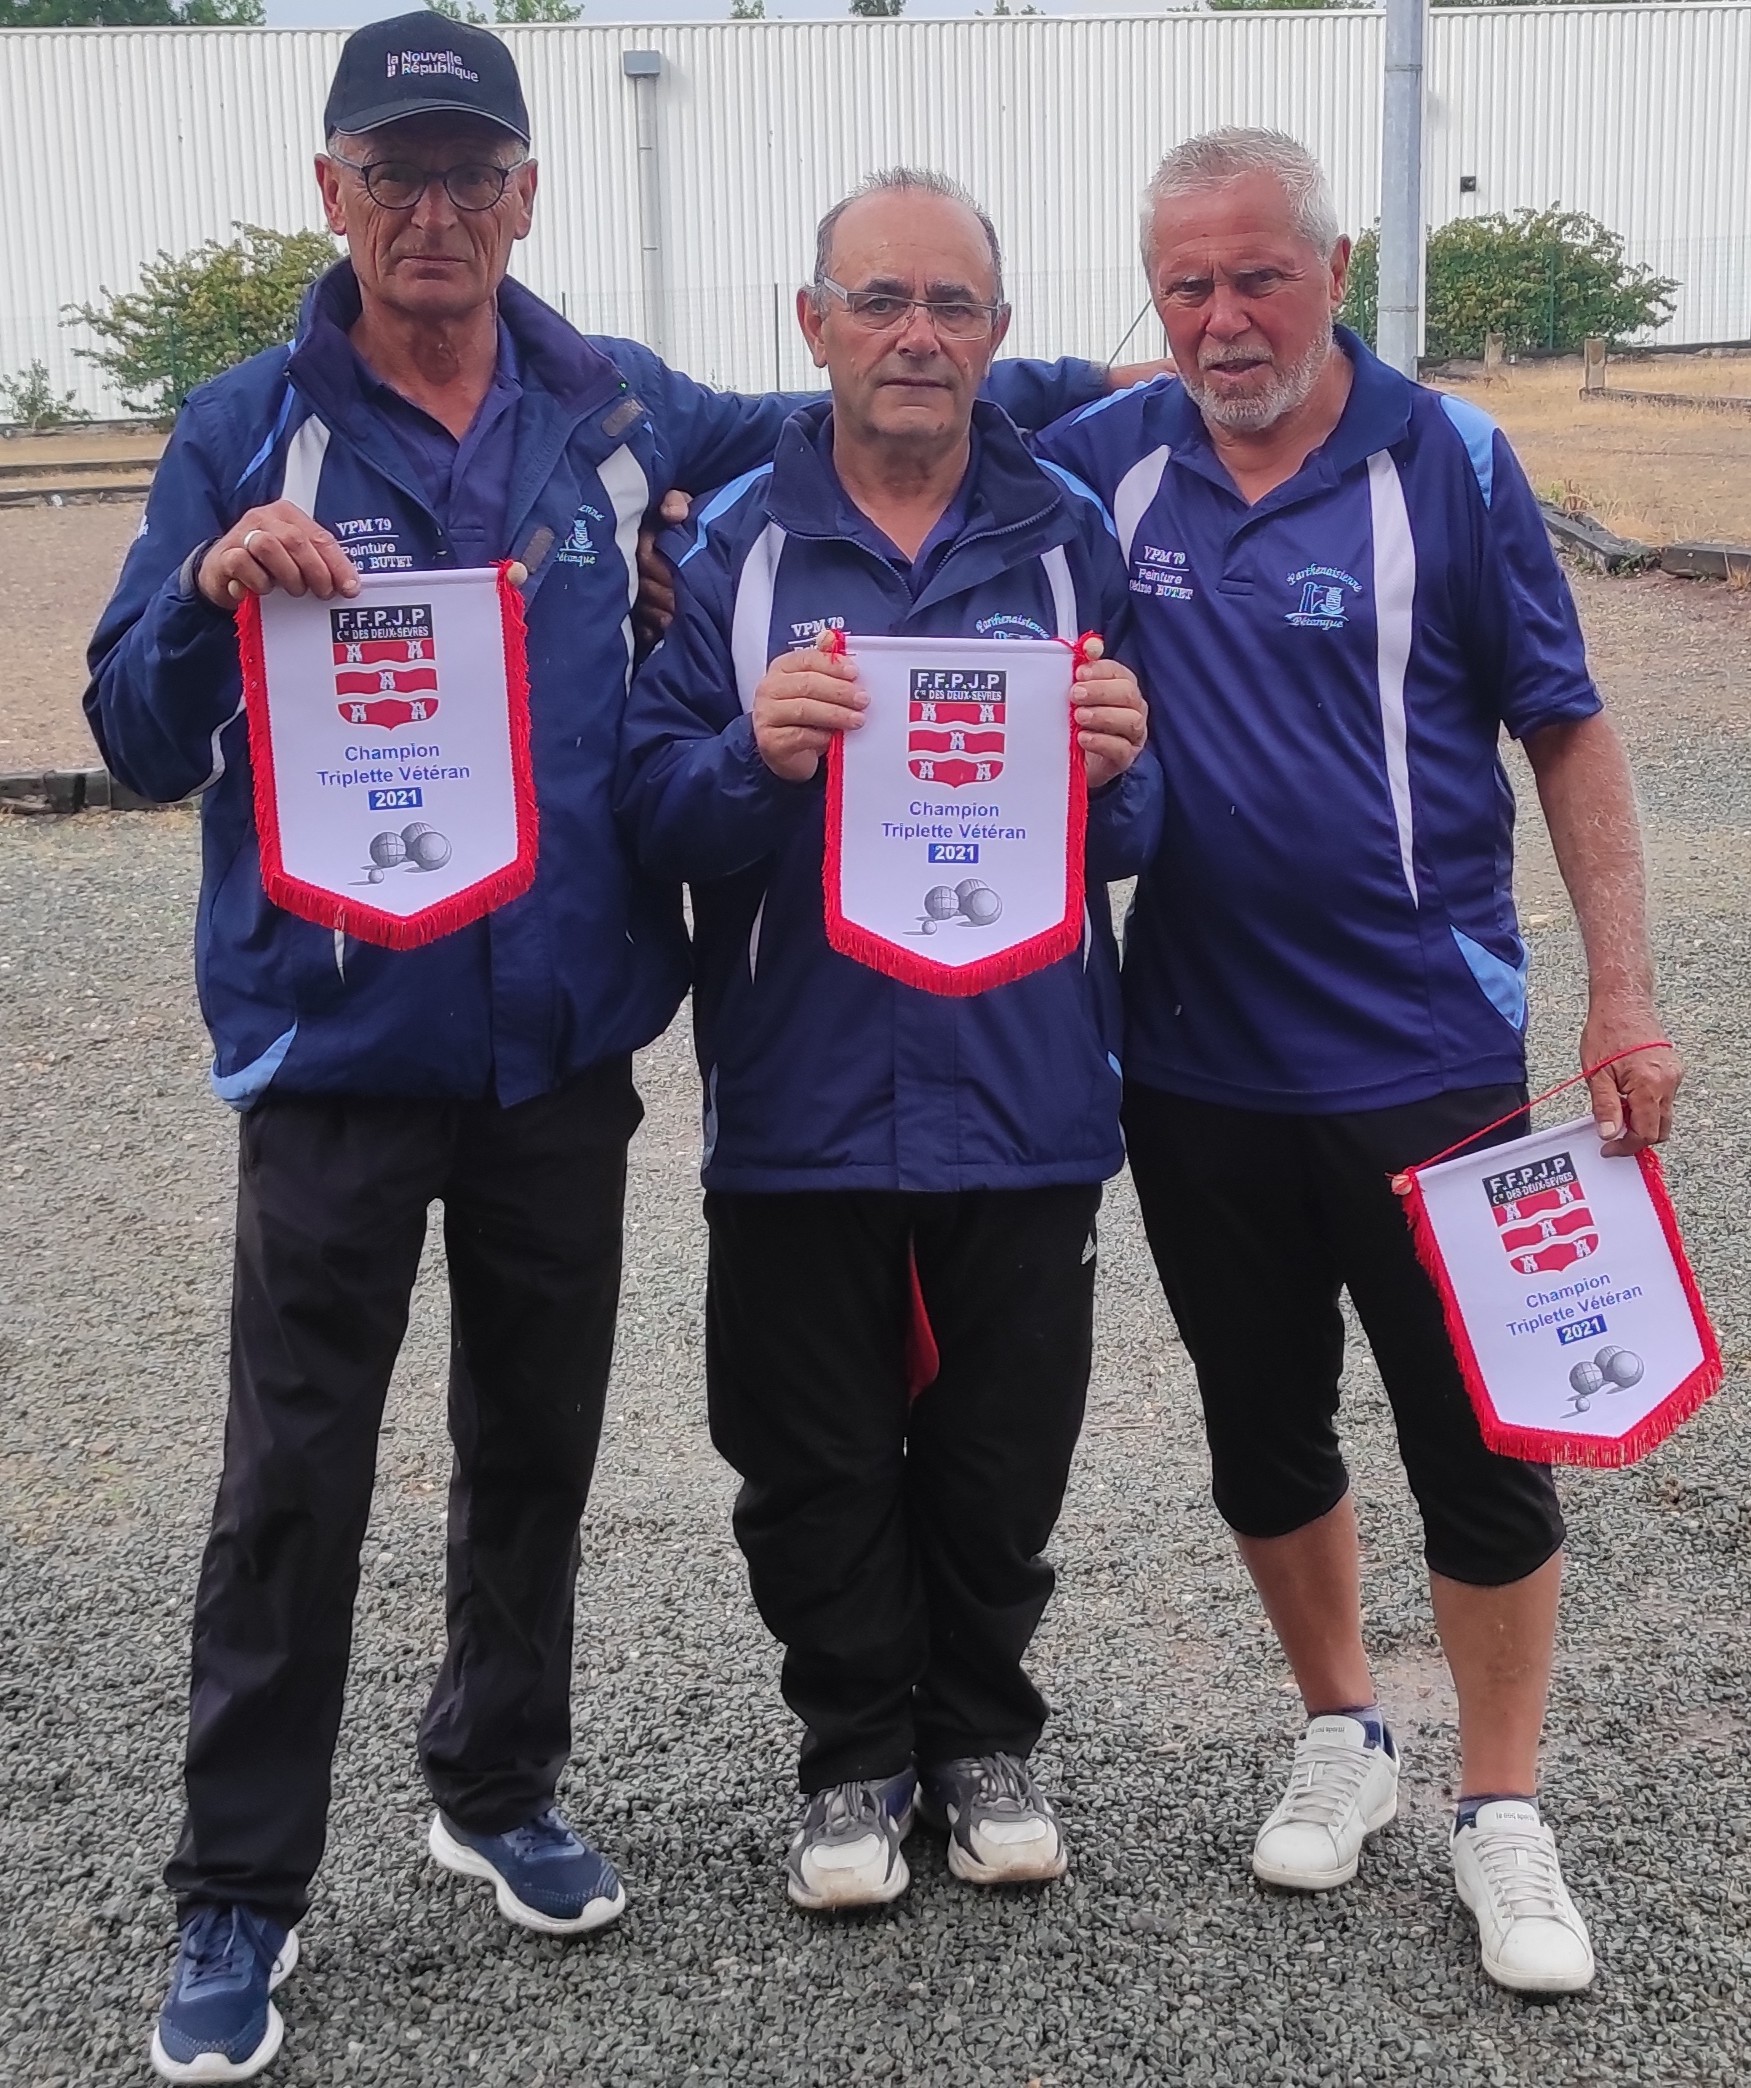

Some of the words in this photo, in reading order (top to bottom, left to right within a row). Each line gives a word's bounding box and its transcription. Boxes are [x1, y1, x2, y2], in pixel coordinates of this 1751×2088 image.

[387, 52, 398, 65] la
[401, 50, 463, 65] Nouvelle
[402, 61, 479, 82] République
[335, 519, 373, 536] VPM
[374, 518, 392, 531] 79
[369, 555, 413, 569] BUTET
[1144, 546, 1172, 563] VPM
[1173, 552, 1186, 564] 79
[1139, 568, 1183, 584] Peinture
[1155, 584, 1193, 599] BUTET
[352, 628, 369, 640] DES
[791, 619, 826, 636] VPM
[828, 617, 845, 629] 79
[929, 690, 944, 700] DES
[345, 743, 440, 762] Champion
[316, 769, 394, 788] Triplette
[399, 765, 470, 781] Vétéran
[375, 789, 419, 807] 2021
[909, 801, 1000, 819] Champion
[881, 823, 954, 840] Triplette
[958, 823, 1026, 839] Vétéran
[934, 845, 975, 861] 2021
[1506, 1188, 1521, 1201] DES
[1526, 1274, 1611, 1308] Champion
[1506, 1307, 1575, 1336] Triplette
[1578, 1286, 1643, 1314] Vétéran
[1562, 1317, 1601, 1342] 2021
